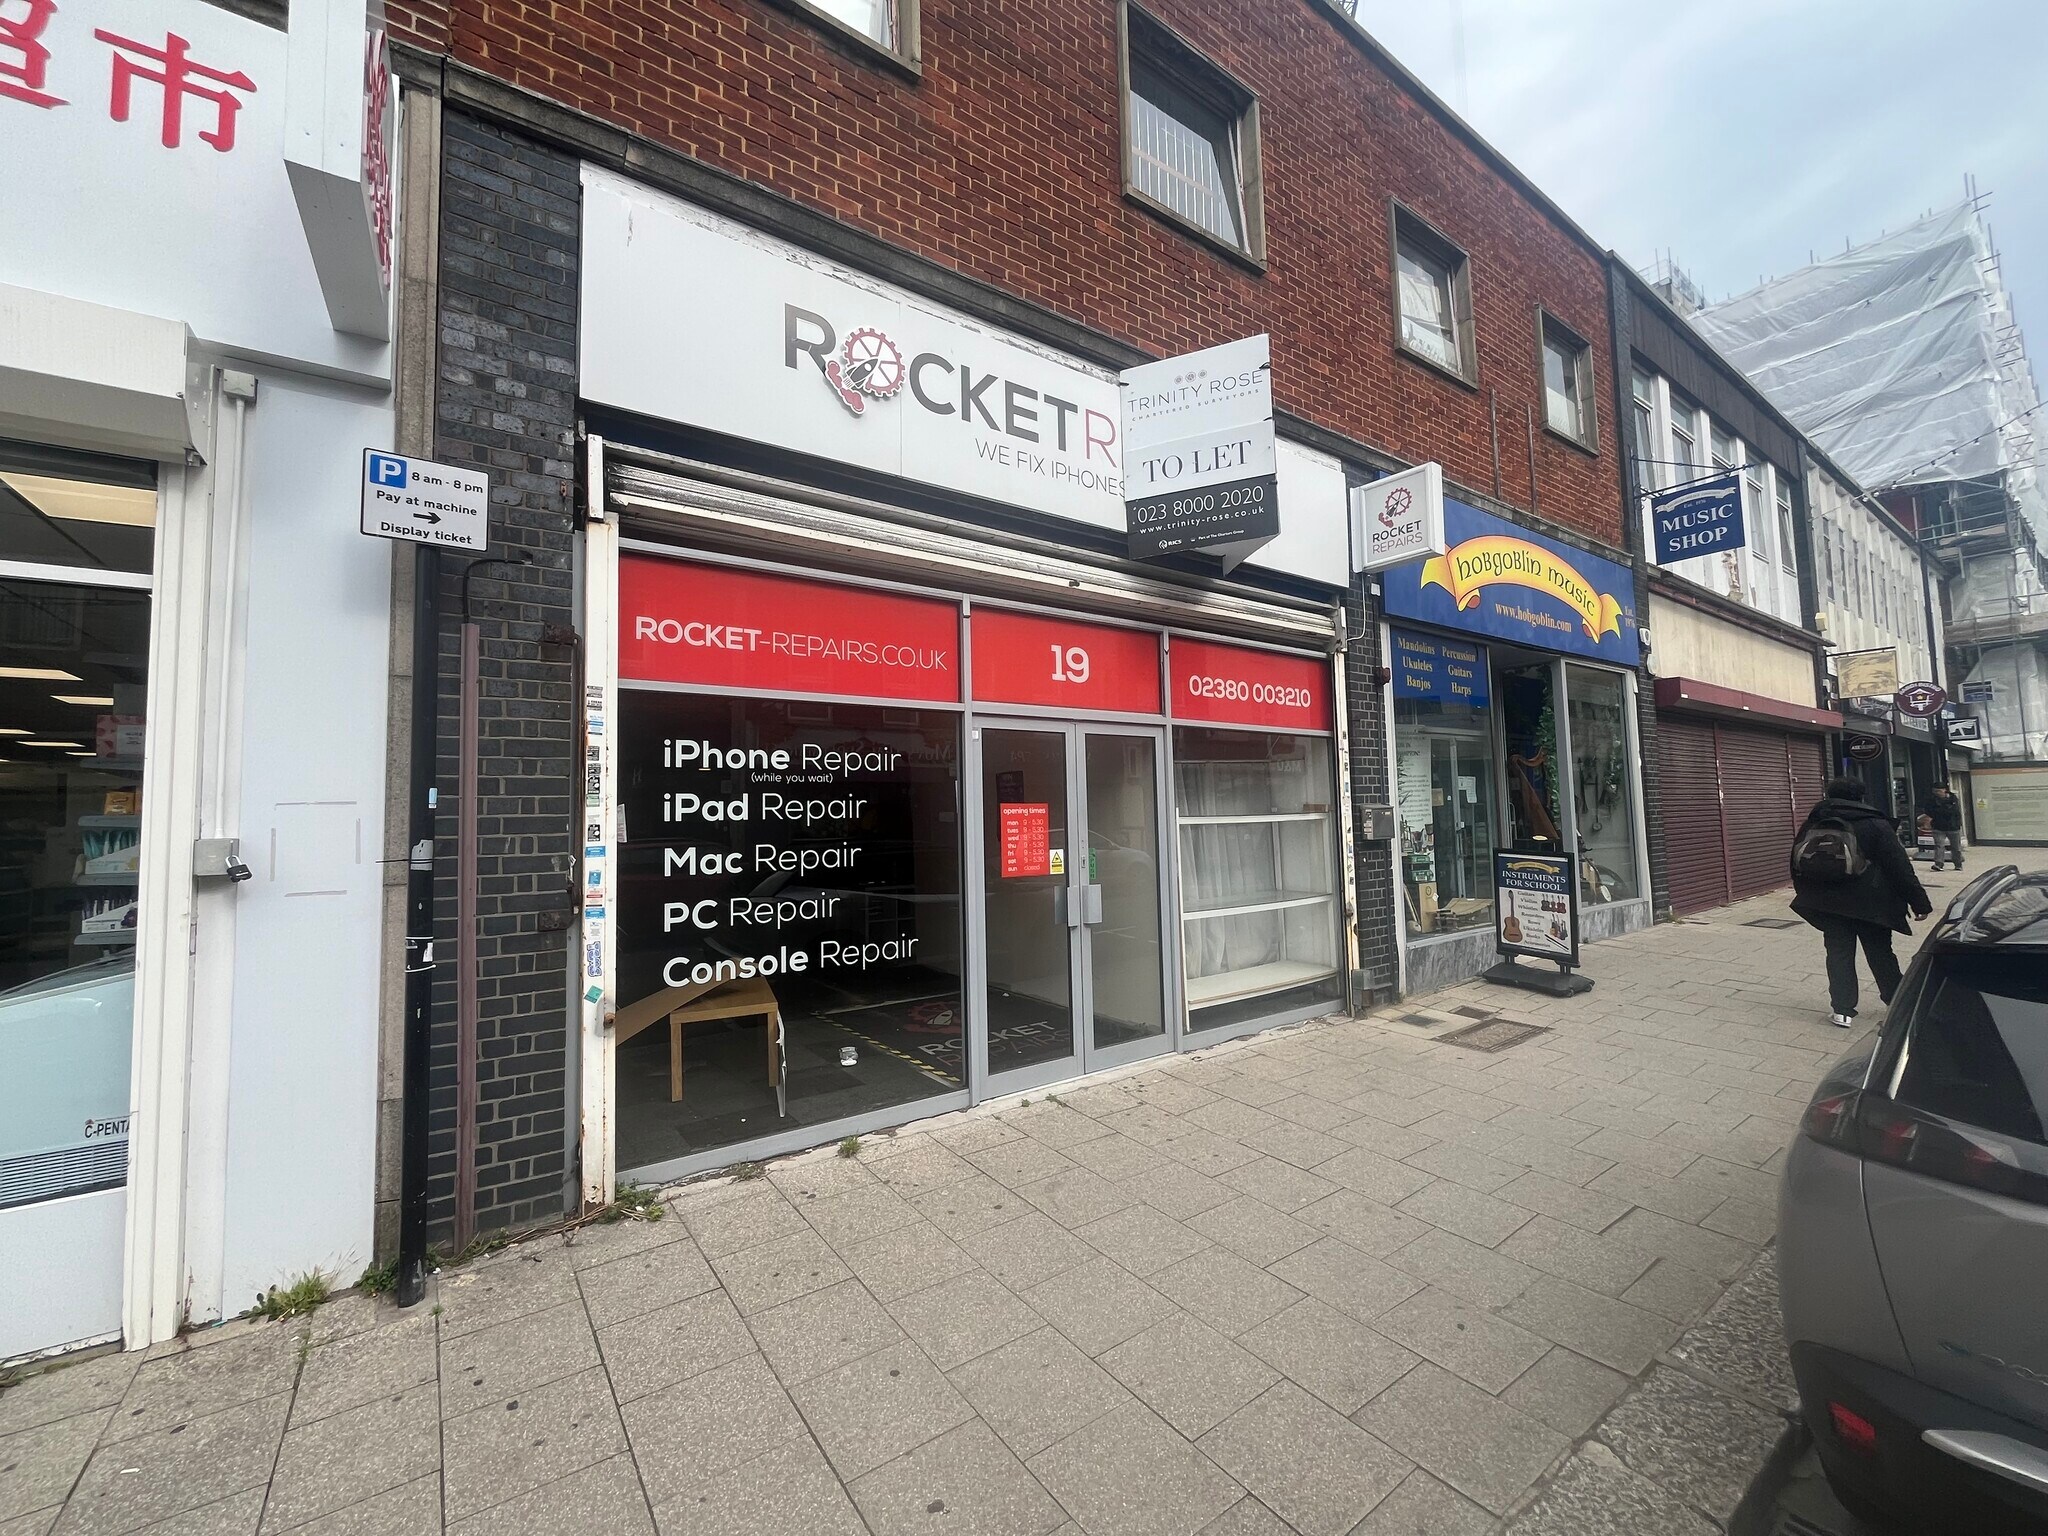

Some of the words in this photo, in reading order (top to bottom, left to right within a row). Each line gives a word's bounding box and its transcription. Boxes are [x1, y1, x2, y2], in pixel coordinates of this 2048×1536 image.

[1128, 384, 1202, 412] TRINITY
[1210, 370, 1263, 394] ROSE
[1132, 405, 1190, 421] CHARTERED
[1198, 389, 1259, 406] SURVEYORS
[379, 459, 402, 482] P
[975, 437, 1010, 466] WE
[1017, 450, 1045, 476] FIX
[1142, 455, 1183, 483] TO
[1192, 440, 1252, 474] LET
[412, 472, 420, 481] 8
[423, 476, 443, 485] am
[453, 480, 461, 489] 8
[464, 484, 483, 493] pm
[376, 490, 401, 504] Pay
[406, 496, 420, 506] at
[424, 500, 477, 516] machine
[1137, 504, 1167, 523] 023
[1173, 495, 1215, 516] 8000
[1220, 486, 1264, 508] 2020
[381, 521, 430, 539] Display
[435, 531, 472, 544] ticket
[1140, 506, 1264, 534] www.trinity-rose.co.uk
[1373, 520, 1422, 543] ROCKET
[1662, 504, 1733, 533] MUSIC
[1373, 532, 1423, 554] REPAIRS
[1669, 527, 1728, 552] SHOP
[1548, 566, 1596, 616] music
[1495, 603, 1572, 633] www.hobgoblin.com
[635, 615, 948, 671] ROCKET-REPAIRS.CO.UK
[1398, 637, 1436, 656] Mandolins
[1442, 646, 1477, 663] Percussion
[1050, 644, 1090, 683] 19
[1402, 656, 1433, 672] Ukuleles
[1448, 665, 1473, 679] Guitars
[1189, 675, 1249, 701] 02380
[1252, 683, 1311, 707] 003210
[1406, 674, 1431, 692] Banjos
[1451, 682, 1472, 697] Harps
[663, 738, 790, 770] iPhone
[802, 743, 902, 777] Repair
[751, 773, 782, 783] (while
[786, 774, 805, 784] you
[808, 772, 833, 784] wait)
[663, 793, 749, 822] iPad
[762, 793, 867, 826] Repair
[1003, 807, 1028, 816] opening
[664, 847, 743, 877] Mac
[755, 841, 862, 877] Repair
[1502, 870, 1566, 884] INSTRUMENTS
[1506, 879, 1522, 887] FOR
[1524, 881, 1562, 891] SCHOOL
[664, 900, 718, 932] PC
[730, 891, 840, 929] Repair
[663, 946, 809, 988] Console
[820, 933, 919, 970] Repair
[918, 1021, 1055, 1055] ROKET
[937, 1029, 1070, 1066] RPAIRS
